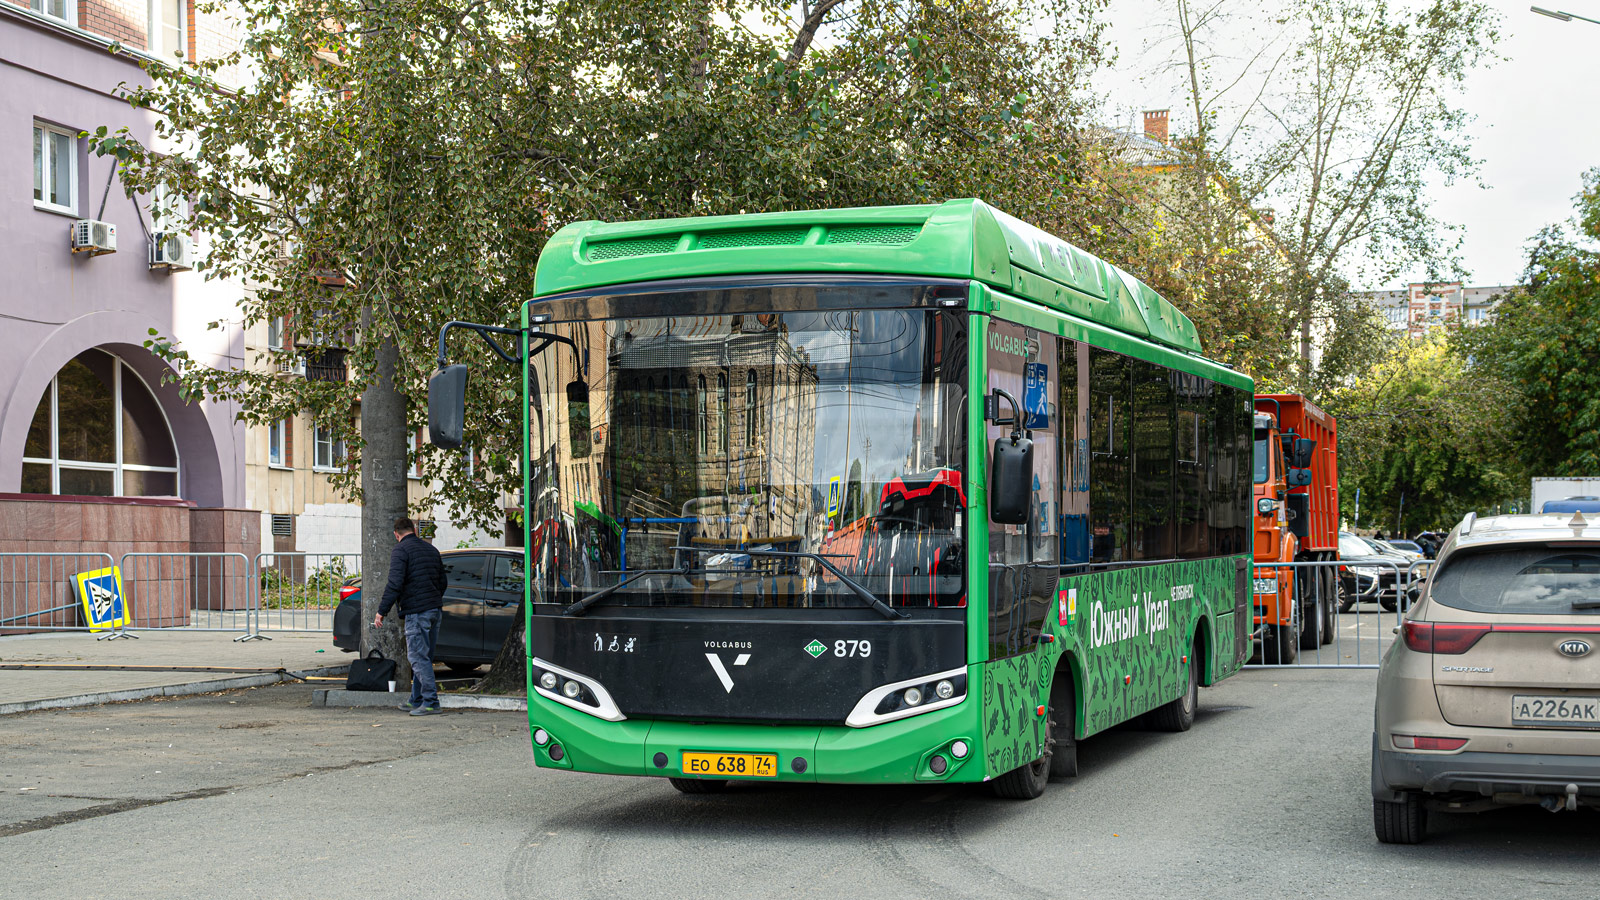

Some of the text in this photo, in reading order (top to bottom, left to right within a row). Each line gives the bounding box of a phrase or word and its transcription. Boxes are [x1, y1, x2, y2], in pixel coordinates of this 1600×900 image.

[989, 331, 1029, 358] VOLGABUS
[1170, 584, 1194, 602] ЧЕЛЯБИНСК
[1090, 591, 1169, 649] Южный Урал
[704, 641, 752, 649] VOLGABUS
[834, 639, 872, 658] 879
[1564, 644, 1585, 653] KIA
[1519, 700, 1596, 719] А226АК
[691, 757, 771, 773] ЕО 638 74
